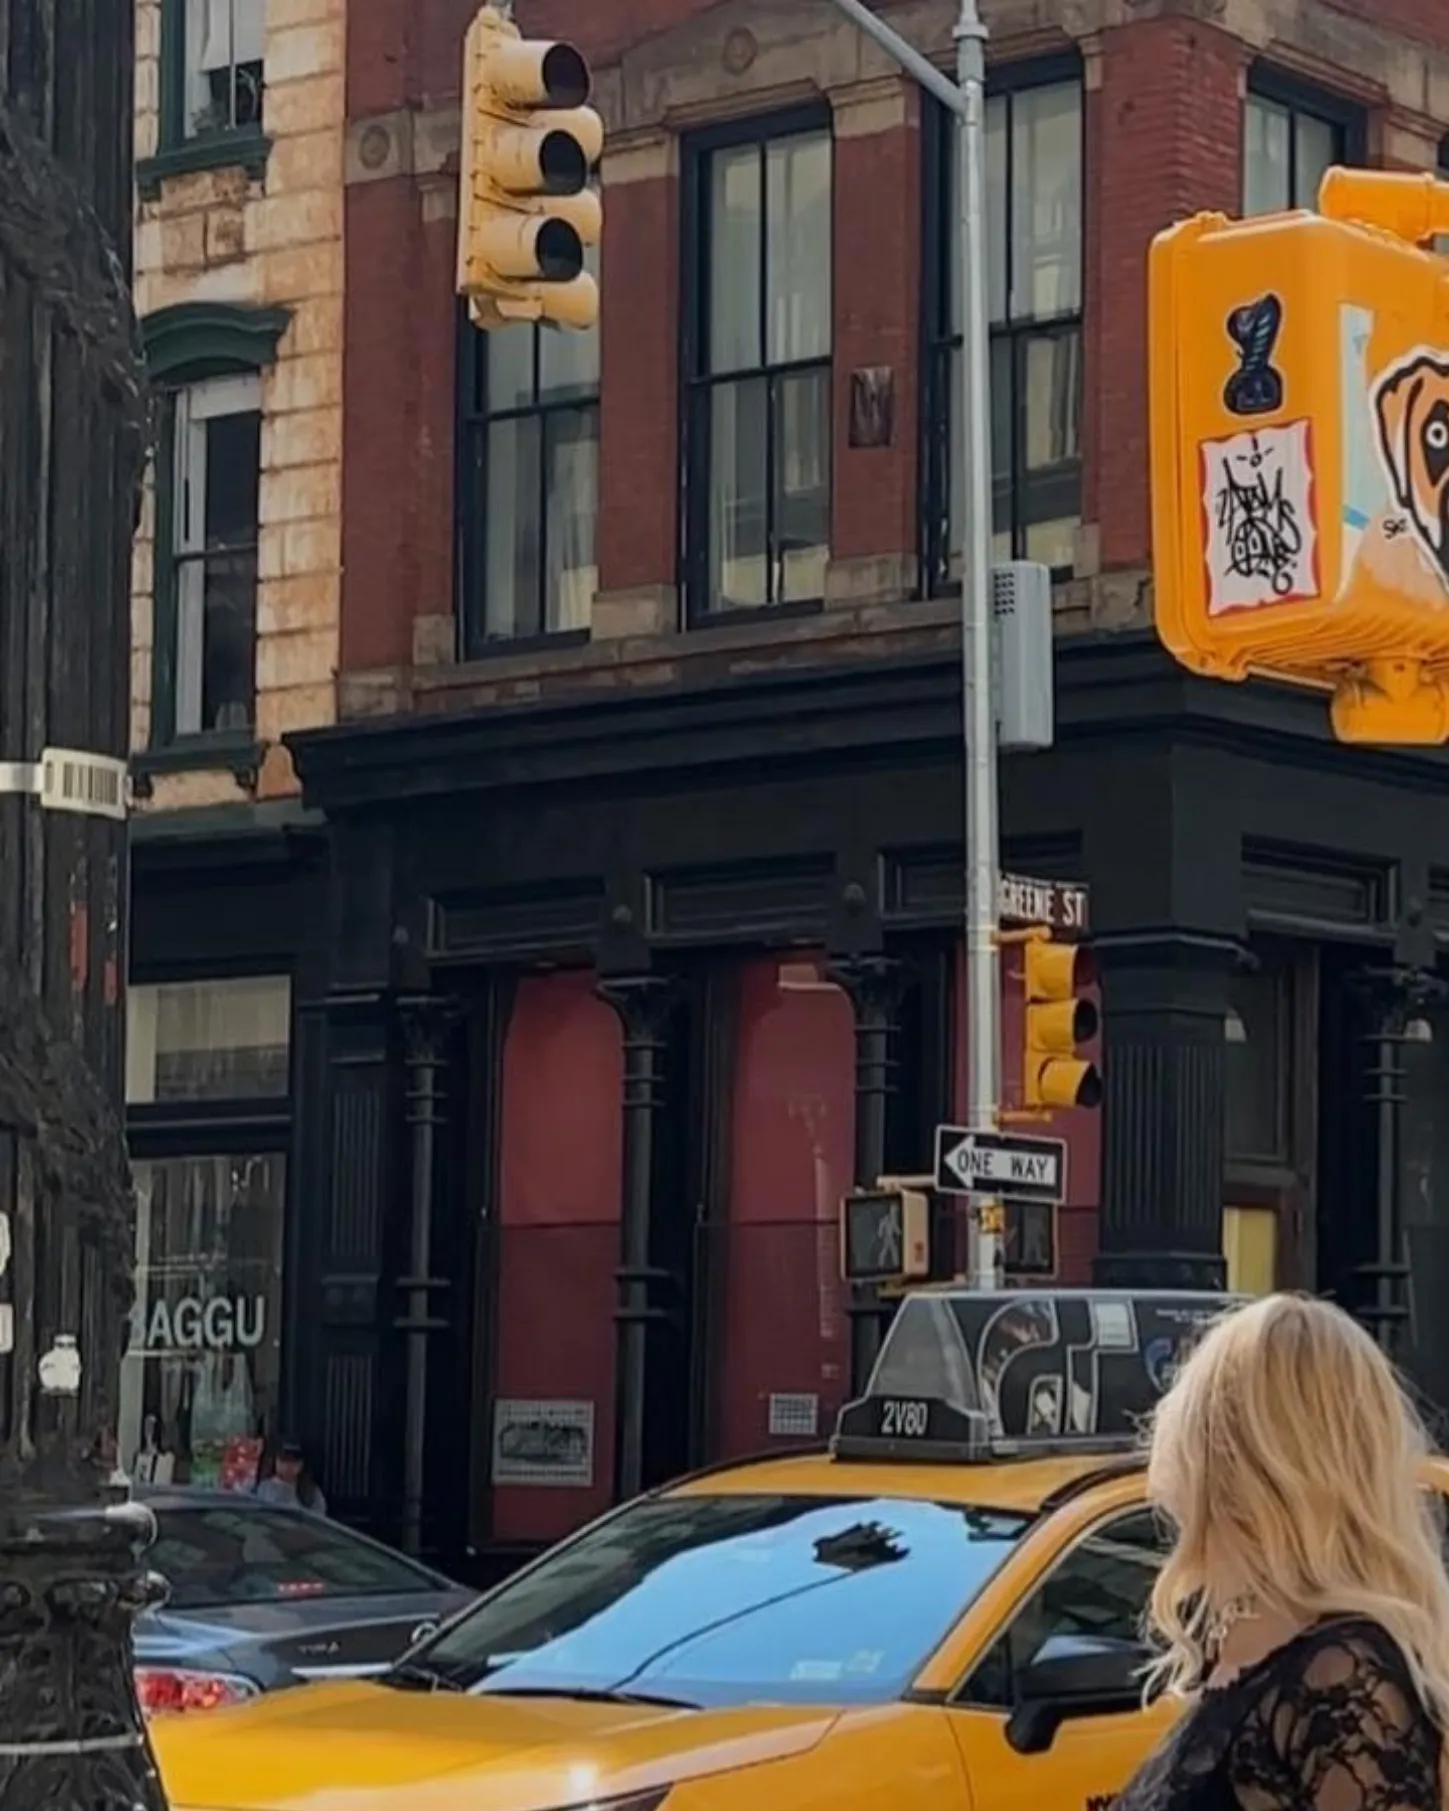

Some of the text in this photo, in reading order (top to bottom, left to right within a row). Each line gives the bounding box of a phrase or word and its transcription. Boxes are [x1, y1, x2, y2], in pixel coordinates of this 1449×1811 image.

[1001, 881, 1087, 927] GREENE ST
[957, 1148, 1048, 1180] ONE WAY
[881, 1400, 929, 1436] 2V80
